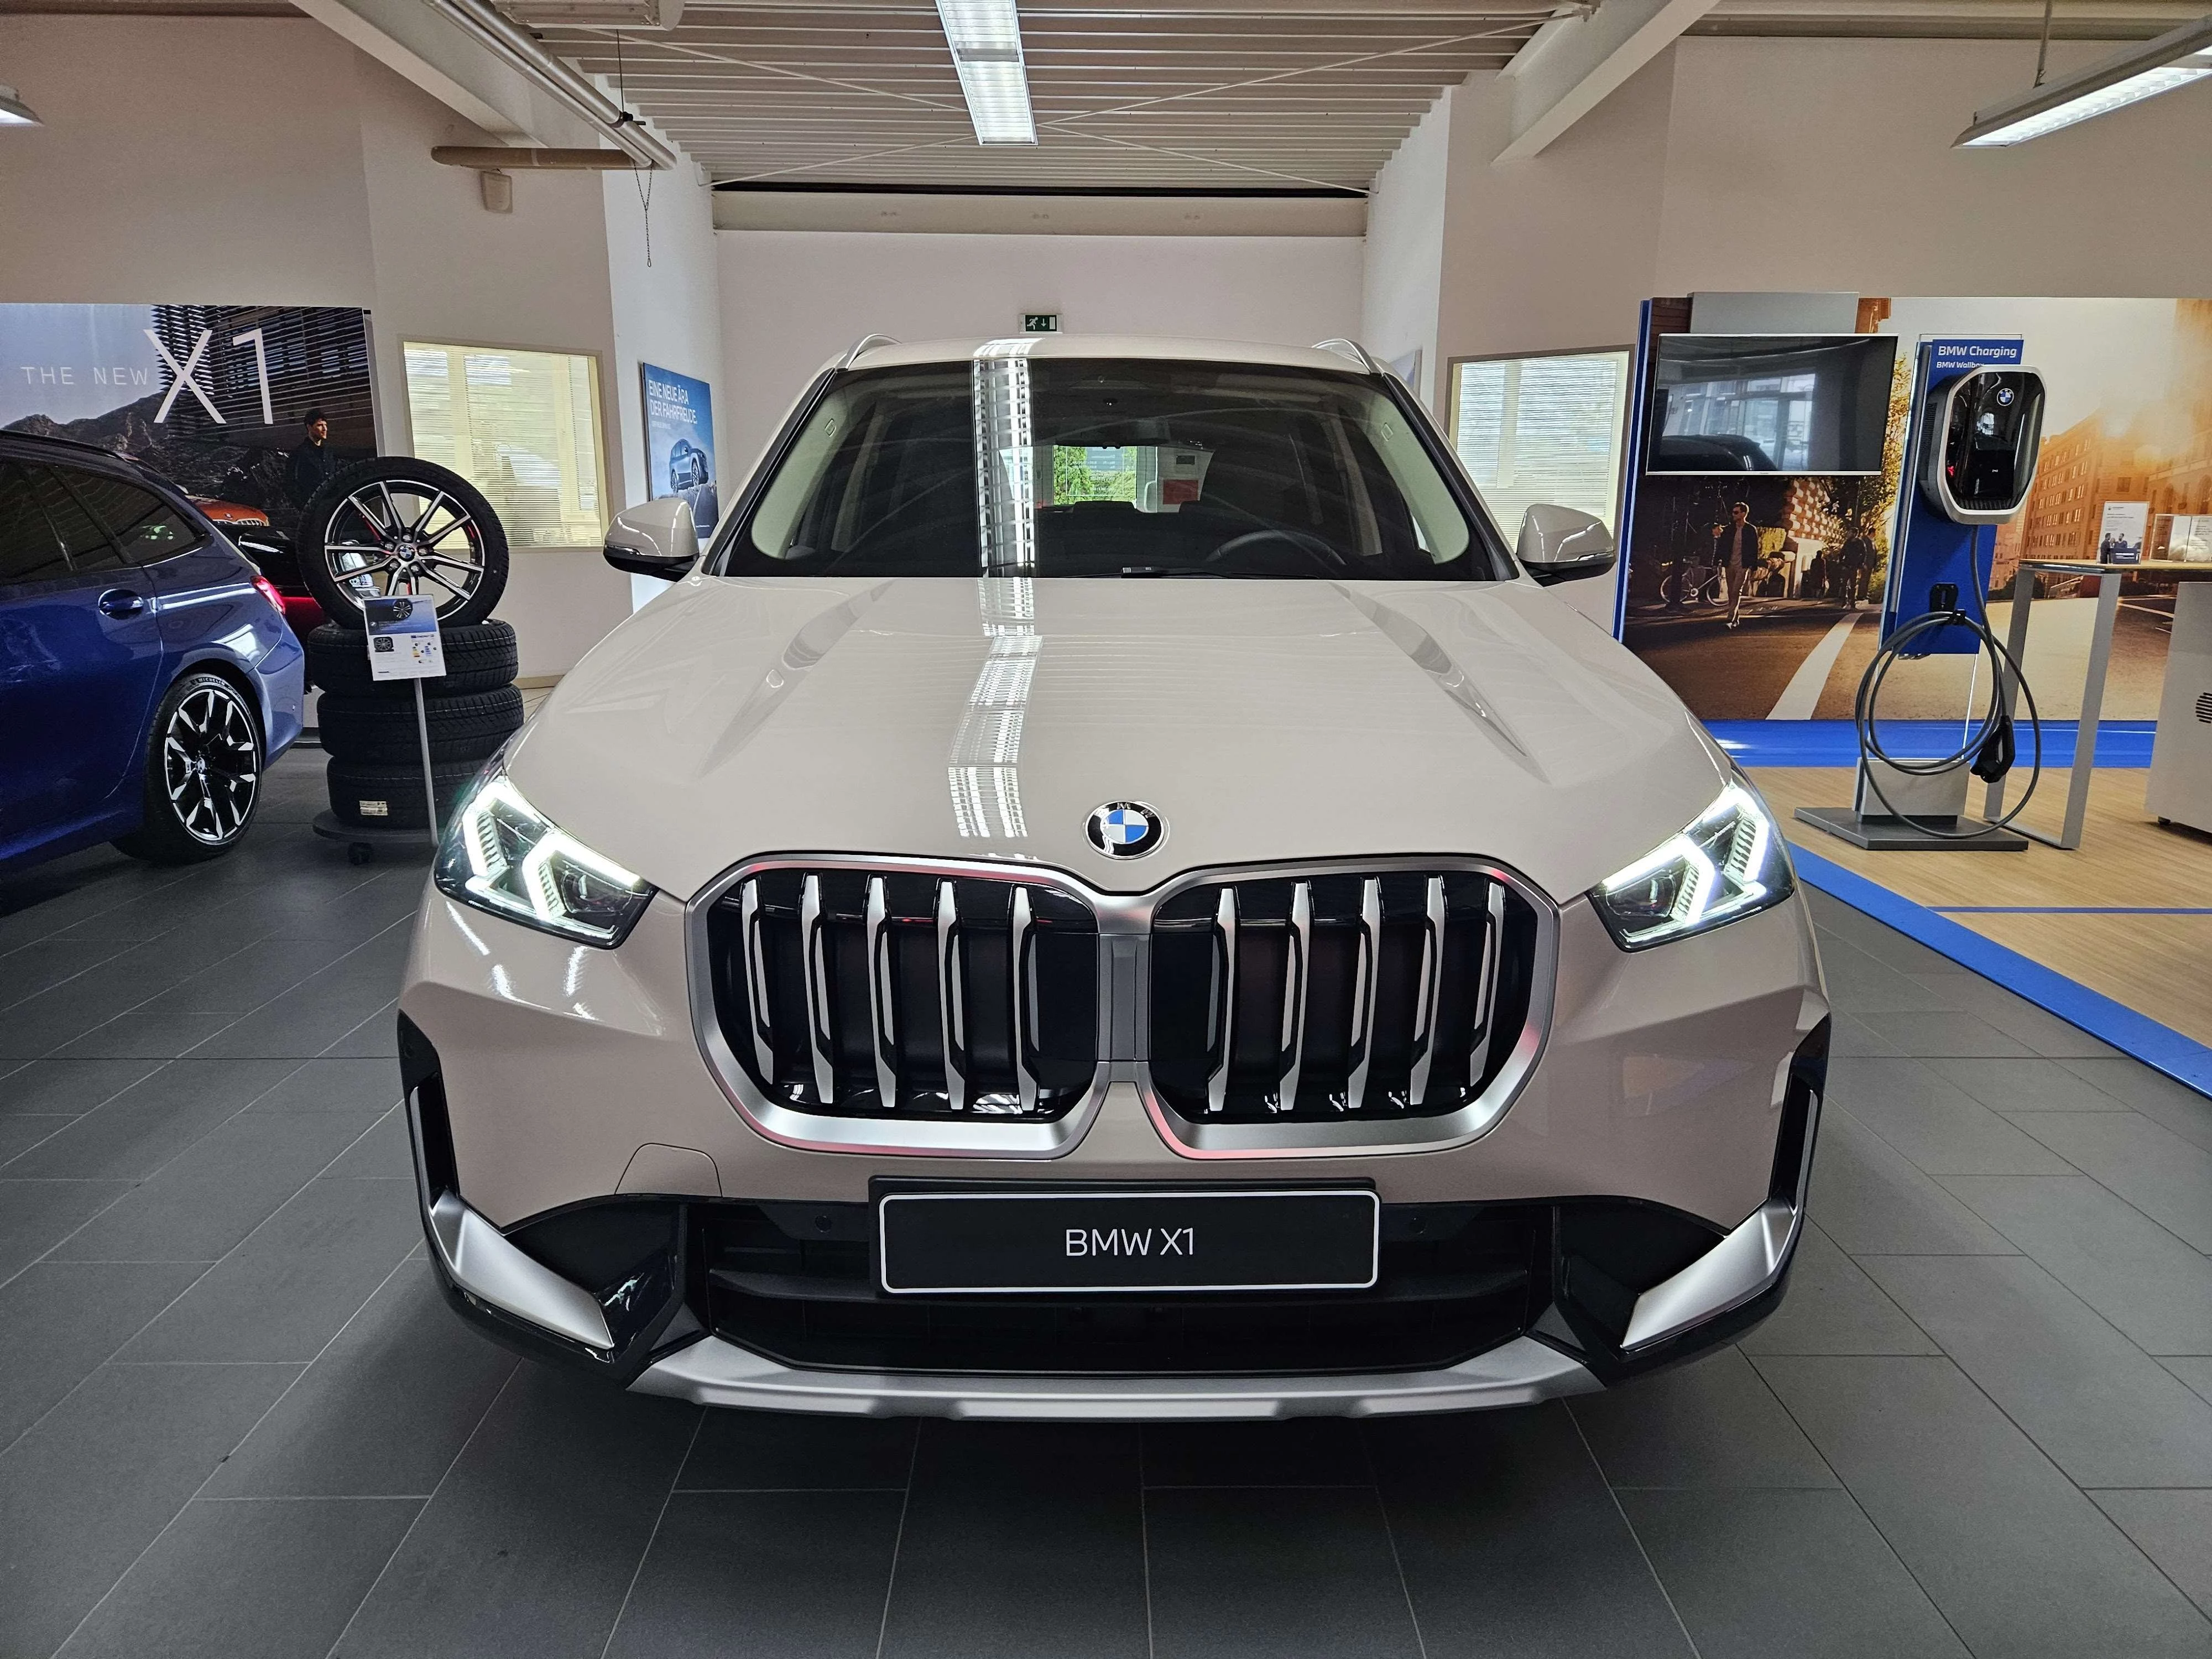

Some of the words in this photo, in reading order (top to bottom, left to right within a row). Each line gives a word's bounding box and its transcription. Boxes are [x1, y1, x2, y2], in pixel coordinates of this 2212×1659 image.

[1938, 346, 1967, 356] BMW
[1969, 346, 2017, 358] Charging
[20, 366, 75, 385] THE
[94, 367, 148, 385] NEW
[143, 328, 274, 425] X1
[649, 379, 662, 398] EINE
[662, 383, 677, 402] NEUE
[677, 384, 689, 405] ÄRA
[650, 399, 662, 416] DER
[662, 402, 697, 424] FAHRFREUDE.
[198, 677, 225, 686] MICHELIN
[1066, 1228, 1152, 1256] BMW
[1160, 1227, 1193, 1255] X1
